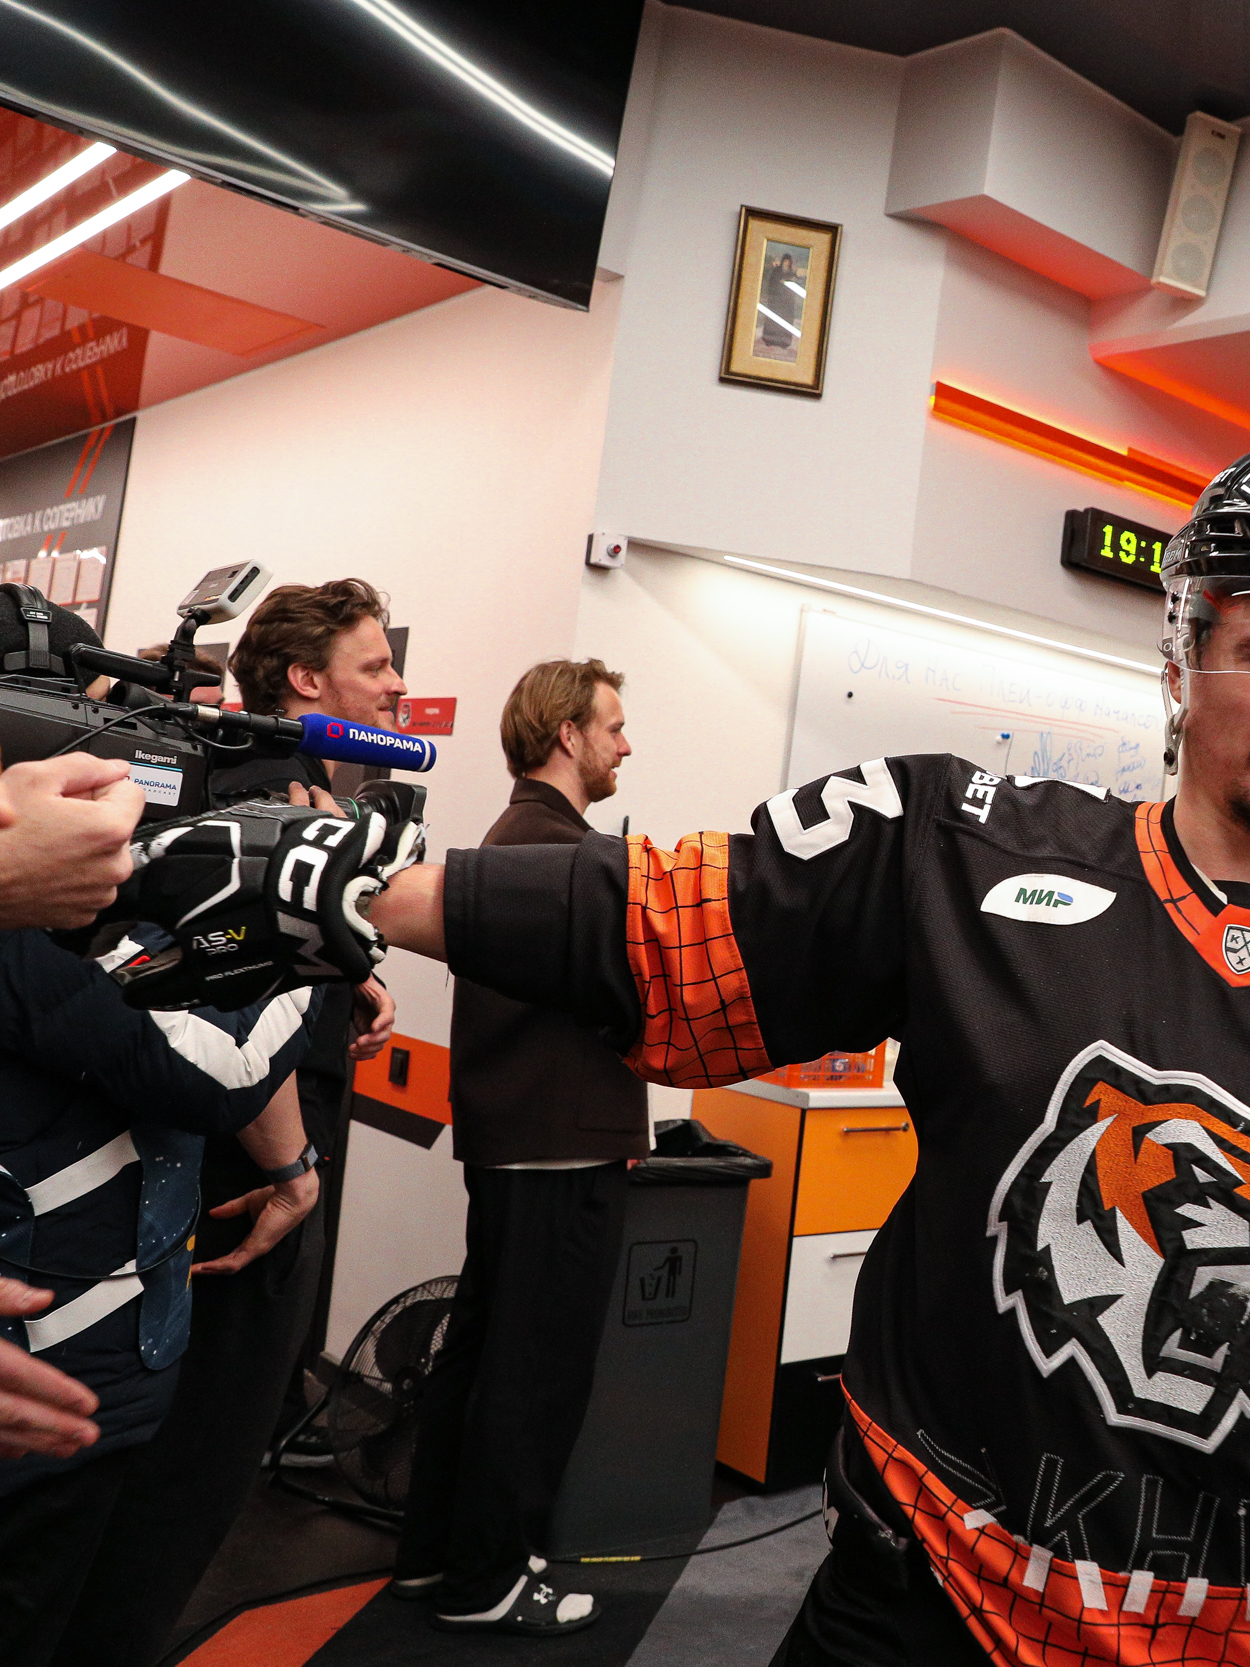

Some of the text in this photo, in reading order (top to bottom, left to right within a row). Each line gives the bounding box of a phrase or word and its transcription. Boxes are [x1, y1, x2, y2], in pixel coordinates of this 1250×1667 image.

[1101, 523, 1162, 574] 19:1
[348, 728, 423, 753] ПАНОРАМА
[135, 749, 178, 764] Ikegami
[134, 778, 177, 791] PANORAMA
